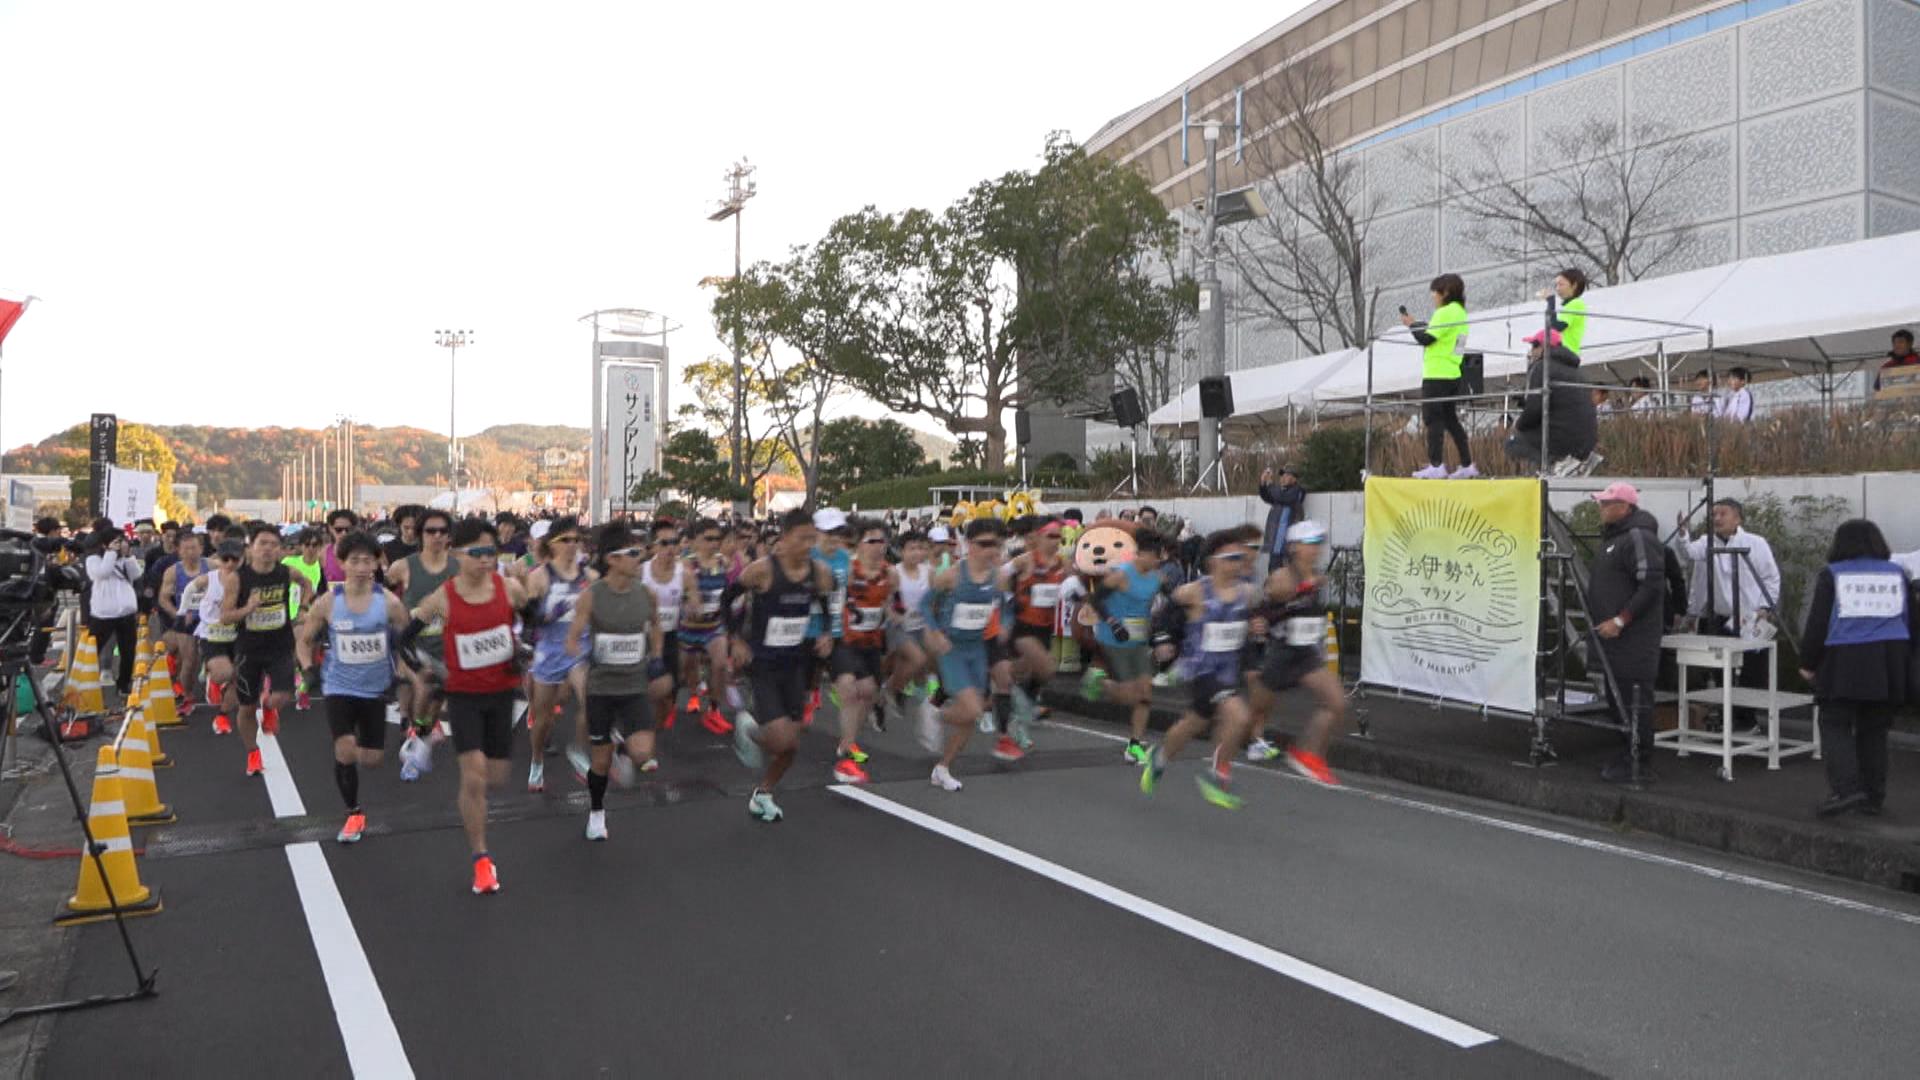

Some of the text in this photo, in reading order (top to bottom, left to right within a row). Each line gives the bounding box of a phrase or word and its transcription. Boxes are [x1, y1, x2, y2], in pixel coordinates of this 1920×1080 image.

[625, 392, 639, 490] サンアリーナ
[1404, 554, 1485, 587] お伊勢さん
[1420, 586, 1466, 602] マラソン
[1426, 661, 1477, 675] MARATHON
